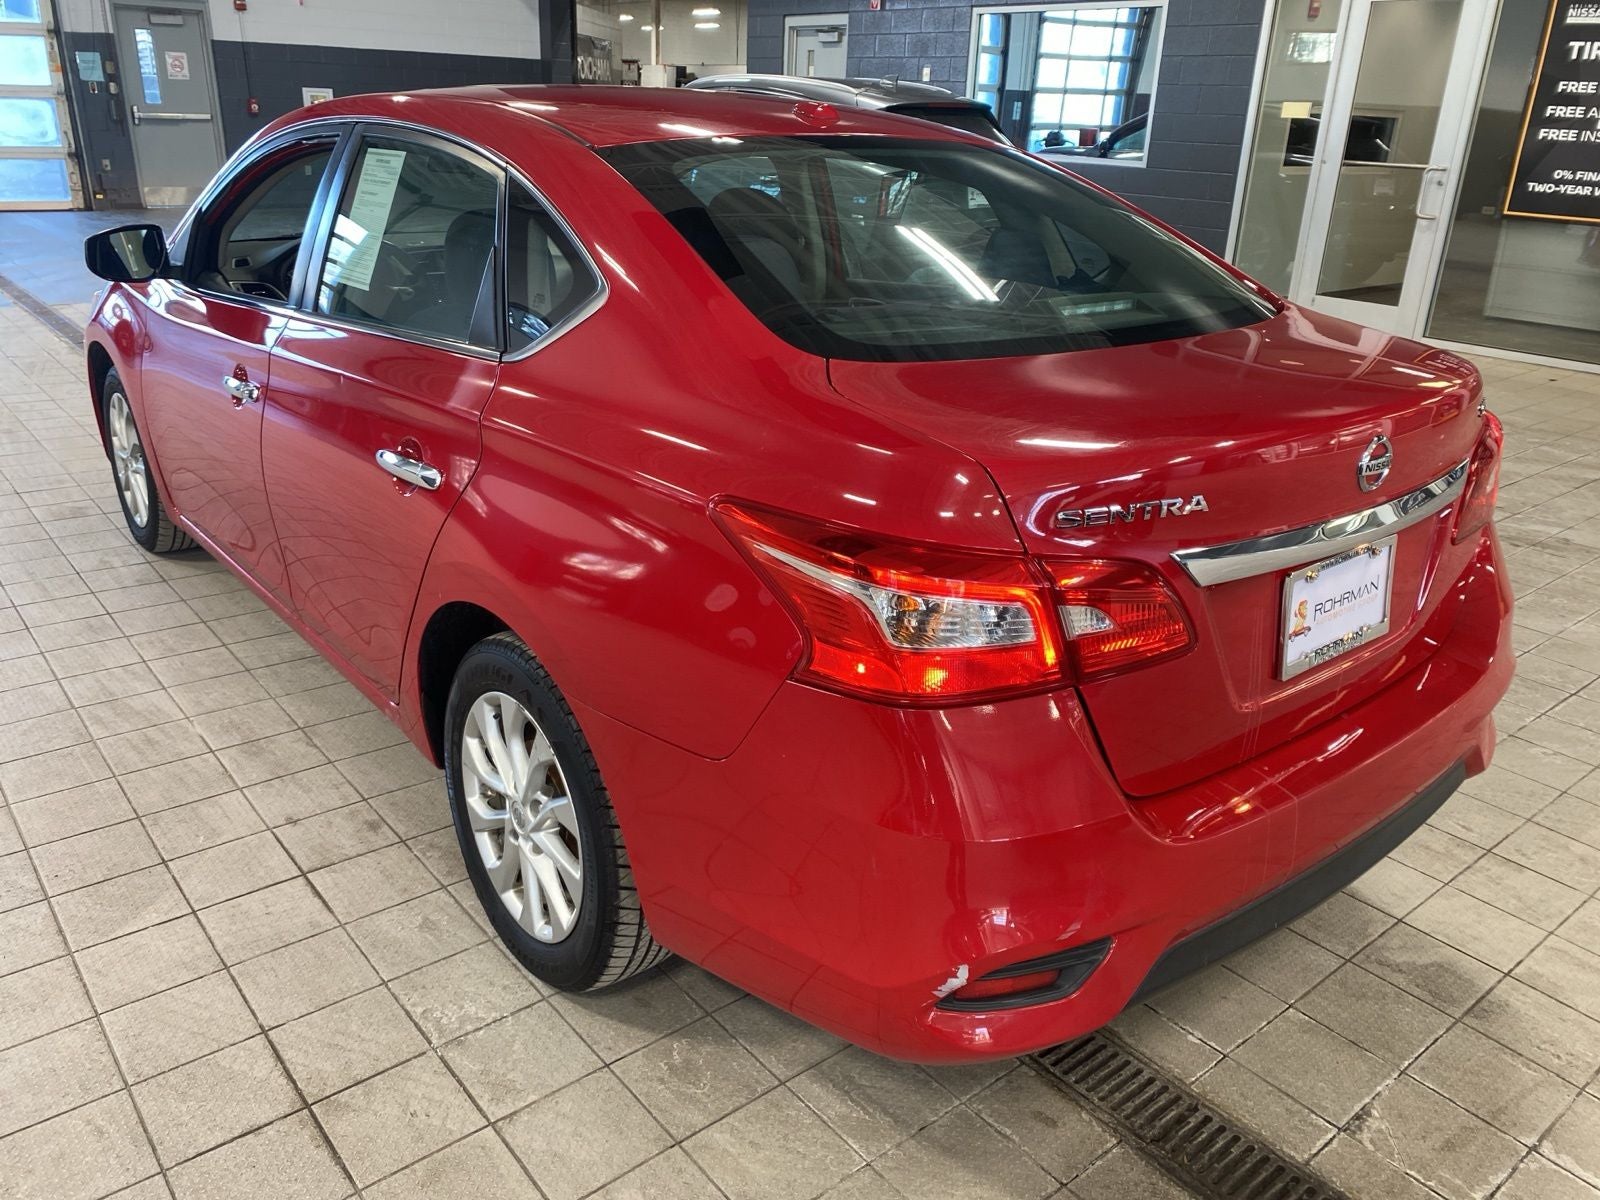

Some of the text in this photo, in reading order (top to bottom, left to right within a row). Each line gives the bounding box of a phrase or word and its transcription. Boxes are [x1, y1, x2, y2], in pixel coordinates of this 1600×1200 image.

[1557, 81, 1599, 94] FREE
[1545, 105, 1586, 118] FREE
[1538, 128, 1579, 141] FREE
[1553, 169, 1574, 180] 0%
[1527, 182, 1593, 195] TWO-YEAR
[1056, 494, 1209, 529] SENTRA
[1313, 574, 1380, 622] ROHRMAN
